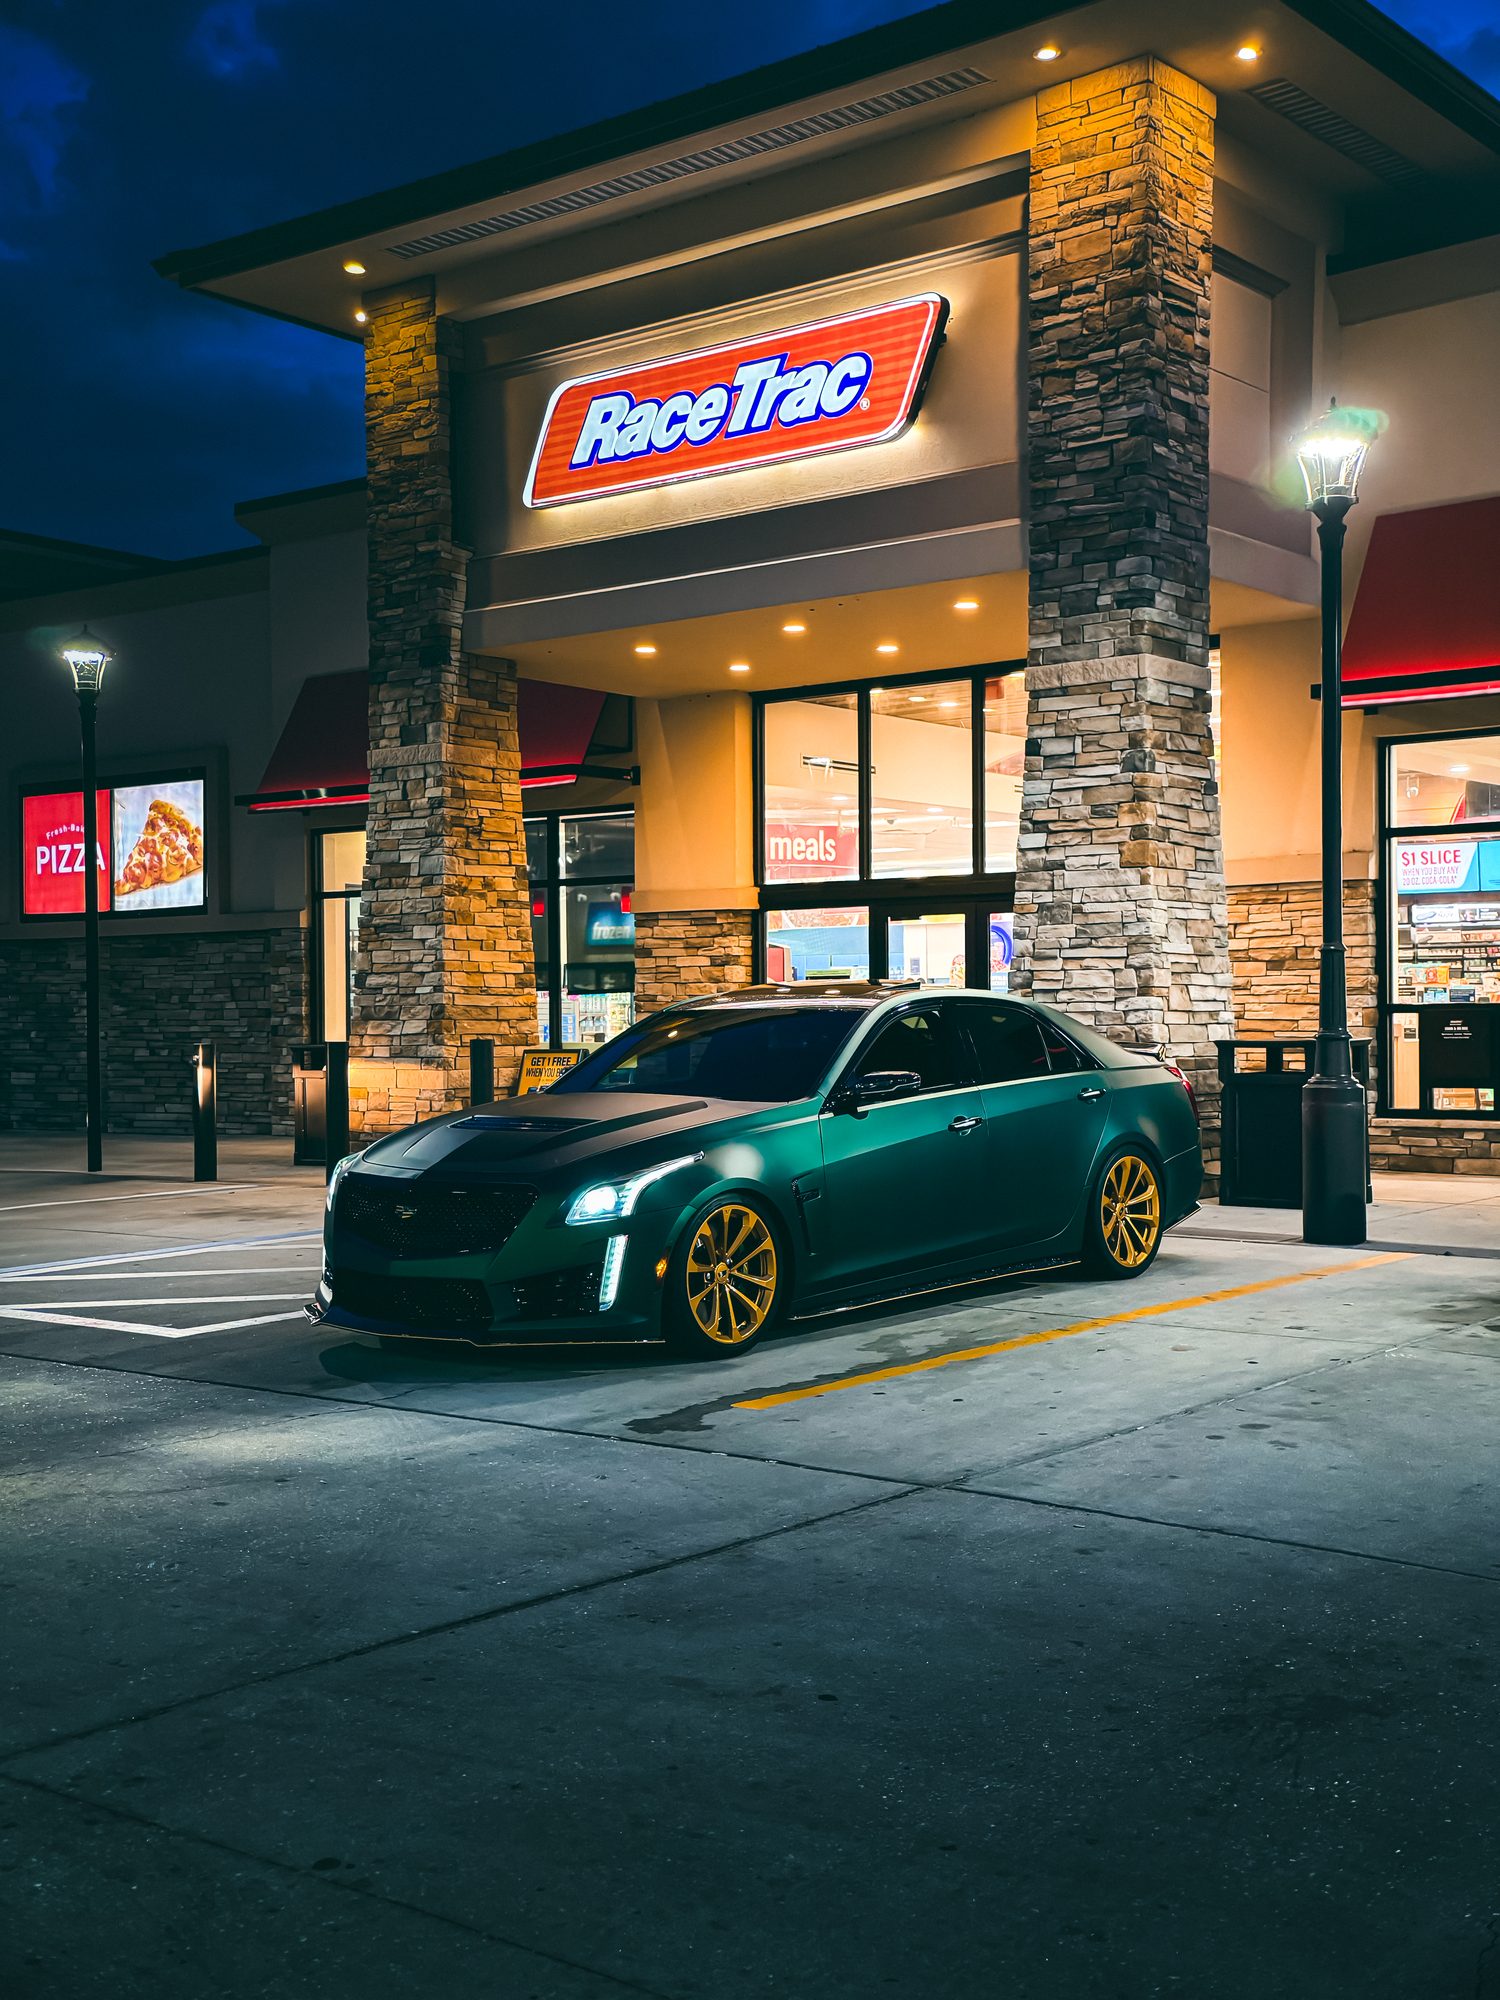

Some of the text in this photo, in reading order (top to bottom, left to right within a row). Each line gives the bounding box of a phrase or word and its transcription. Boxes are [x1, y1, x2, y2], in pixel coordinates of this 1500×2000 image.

[570, 353, 870, 467] RaceTrac
[46, 823, 85, 840] Fresh-Bak
[769, 829, 837, 862] meals
[1401, 849, 1462, 867] $1 SLICE
[1402, 866, 1459, 877] WHEN YOU BUY ANY
[592, 921, 631, 940] frozen
[531, 1056, 547, 1066] GET
[552, 1056, 572, 1066] FREE
[526, 1067, 543, 1078] WHEN
[544, 1067, 556, 1078] YOU
